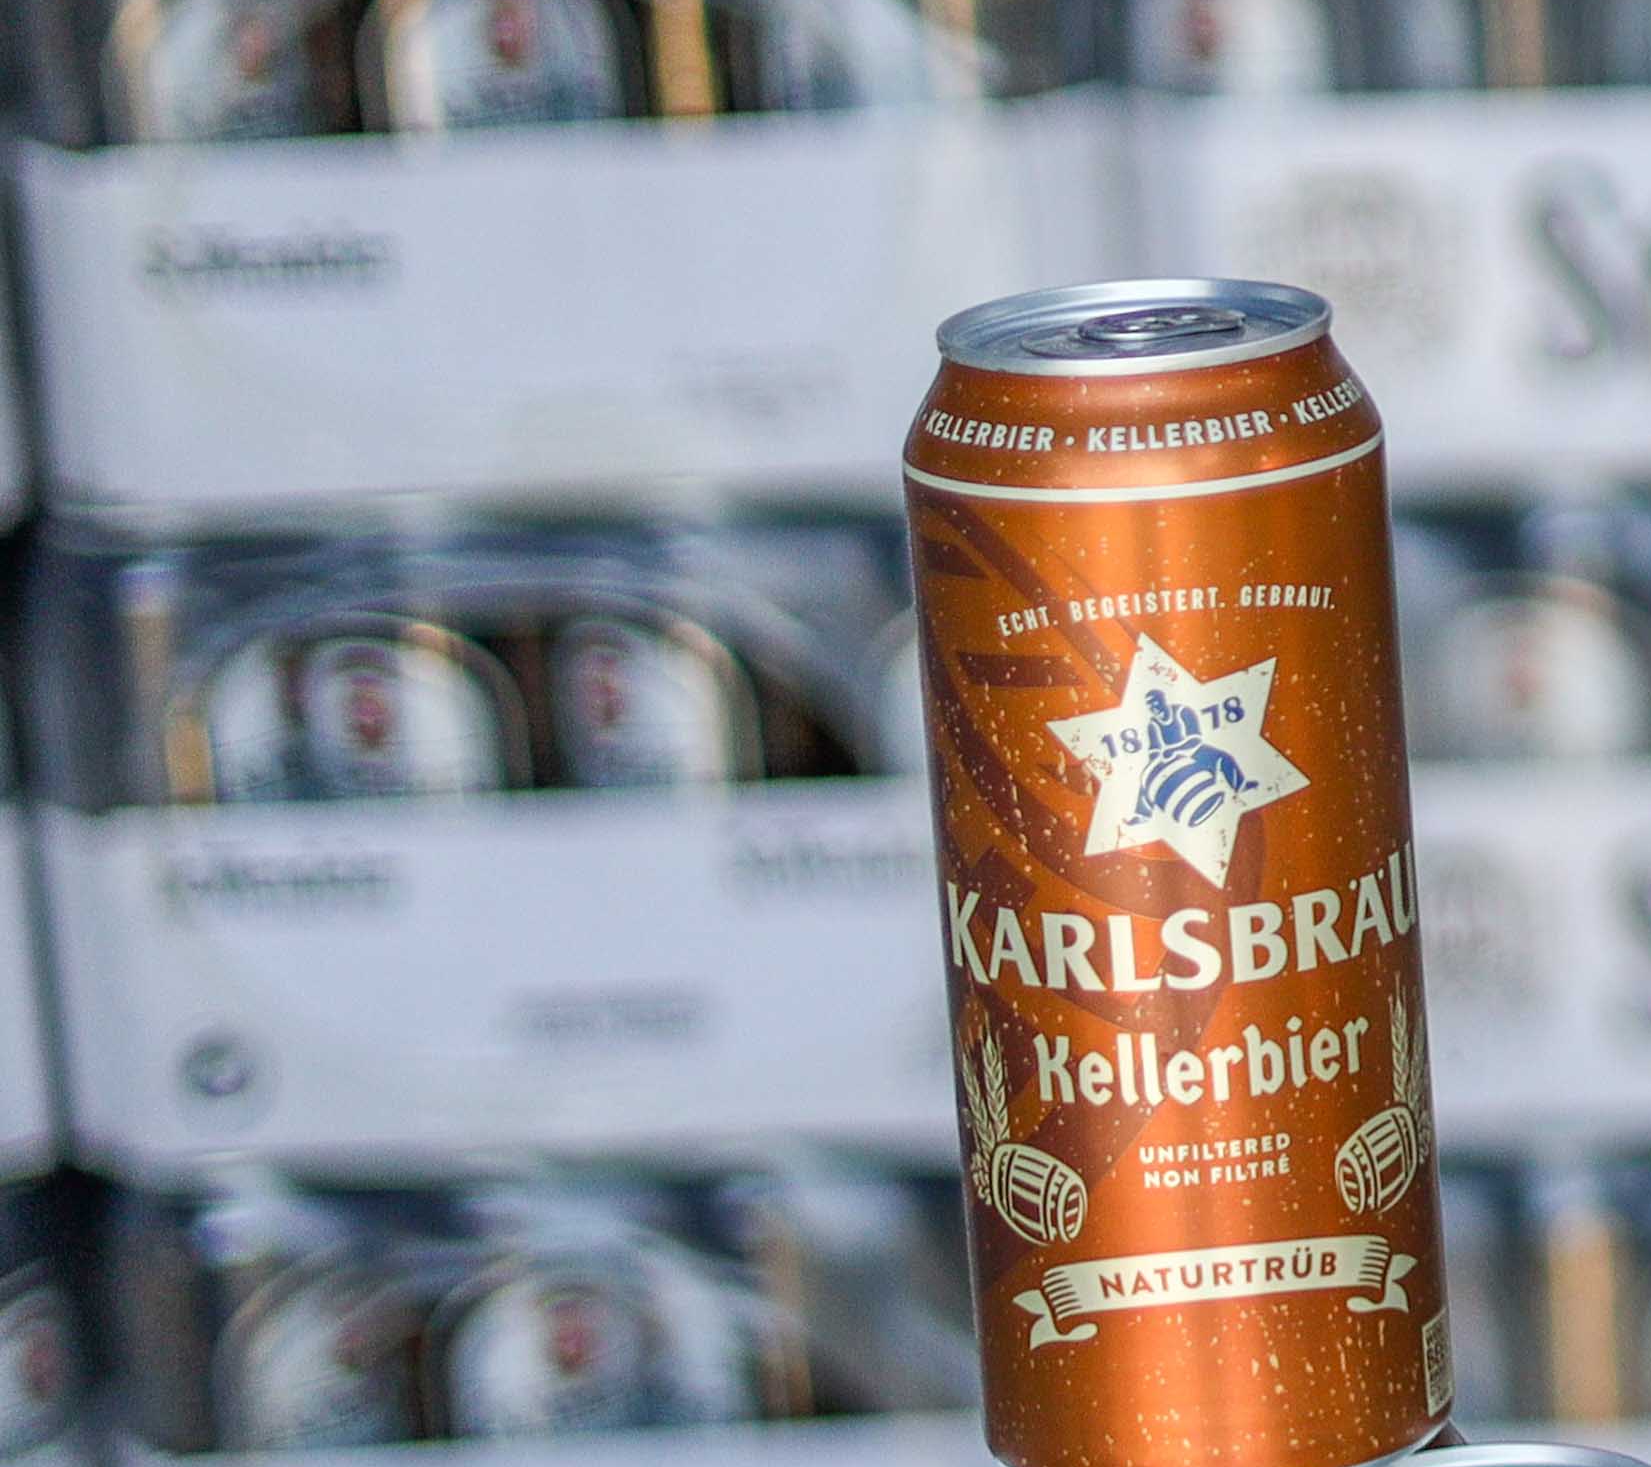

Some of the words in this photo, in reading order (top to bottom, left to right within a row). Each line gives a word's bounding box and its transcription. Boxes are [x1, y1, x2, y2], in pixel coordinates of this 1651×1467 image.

[1088, 411, 1274, 452] KELLERBIER
[999, 605, 1058, 637] ECHT.
[1070, 585, 1226, 622] BEGEISTERT.
[1240, 586, 1335, 610] GEBRAUT.
[946, 842, 1417, 993] KARLSBRÄU
[1034, 1015, 1369, 1107] Kellerbier
[1139, 1132, 1290, 1164] UNFILTERED
[1144, 1167, 1200, 1189] NON
[1210, 1156, 1290, 1184] FILTRÉ
[1098, 1253, 1337, 1298] NATURTRÜB
